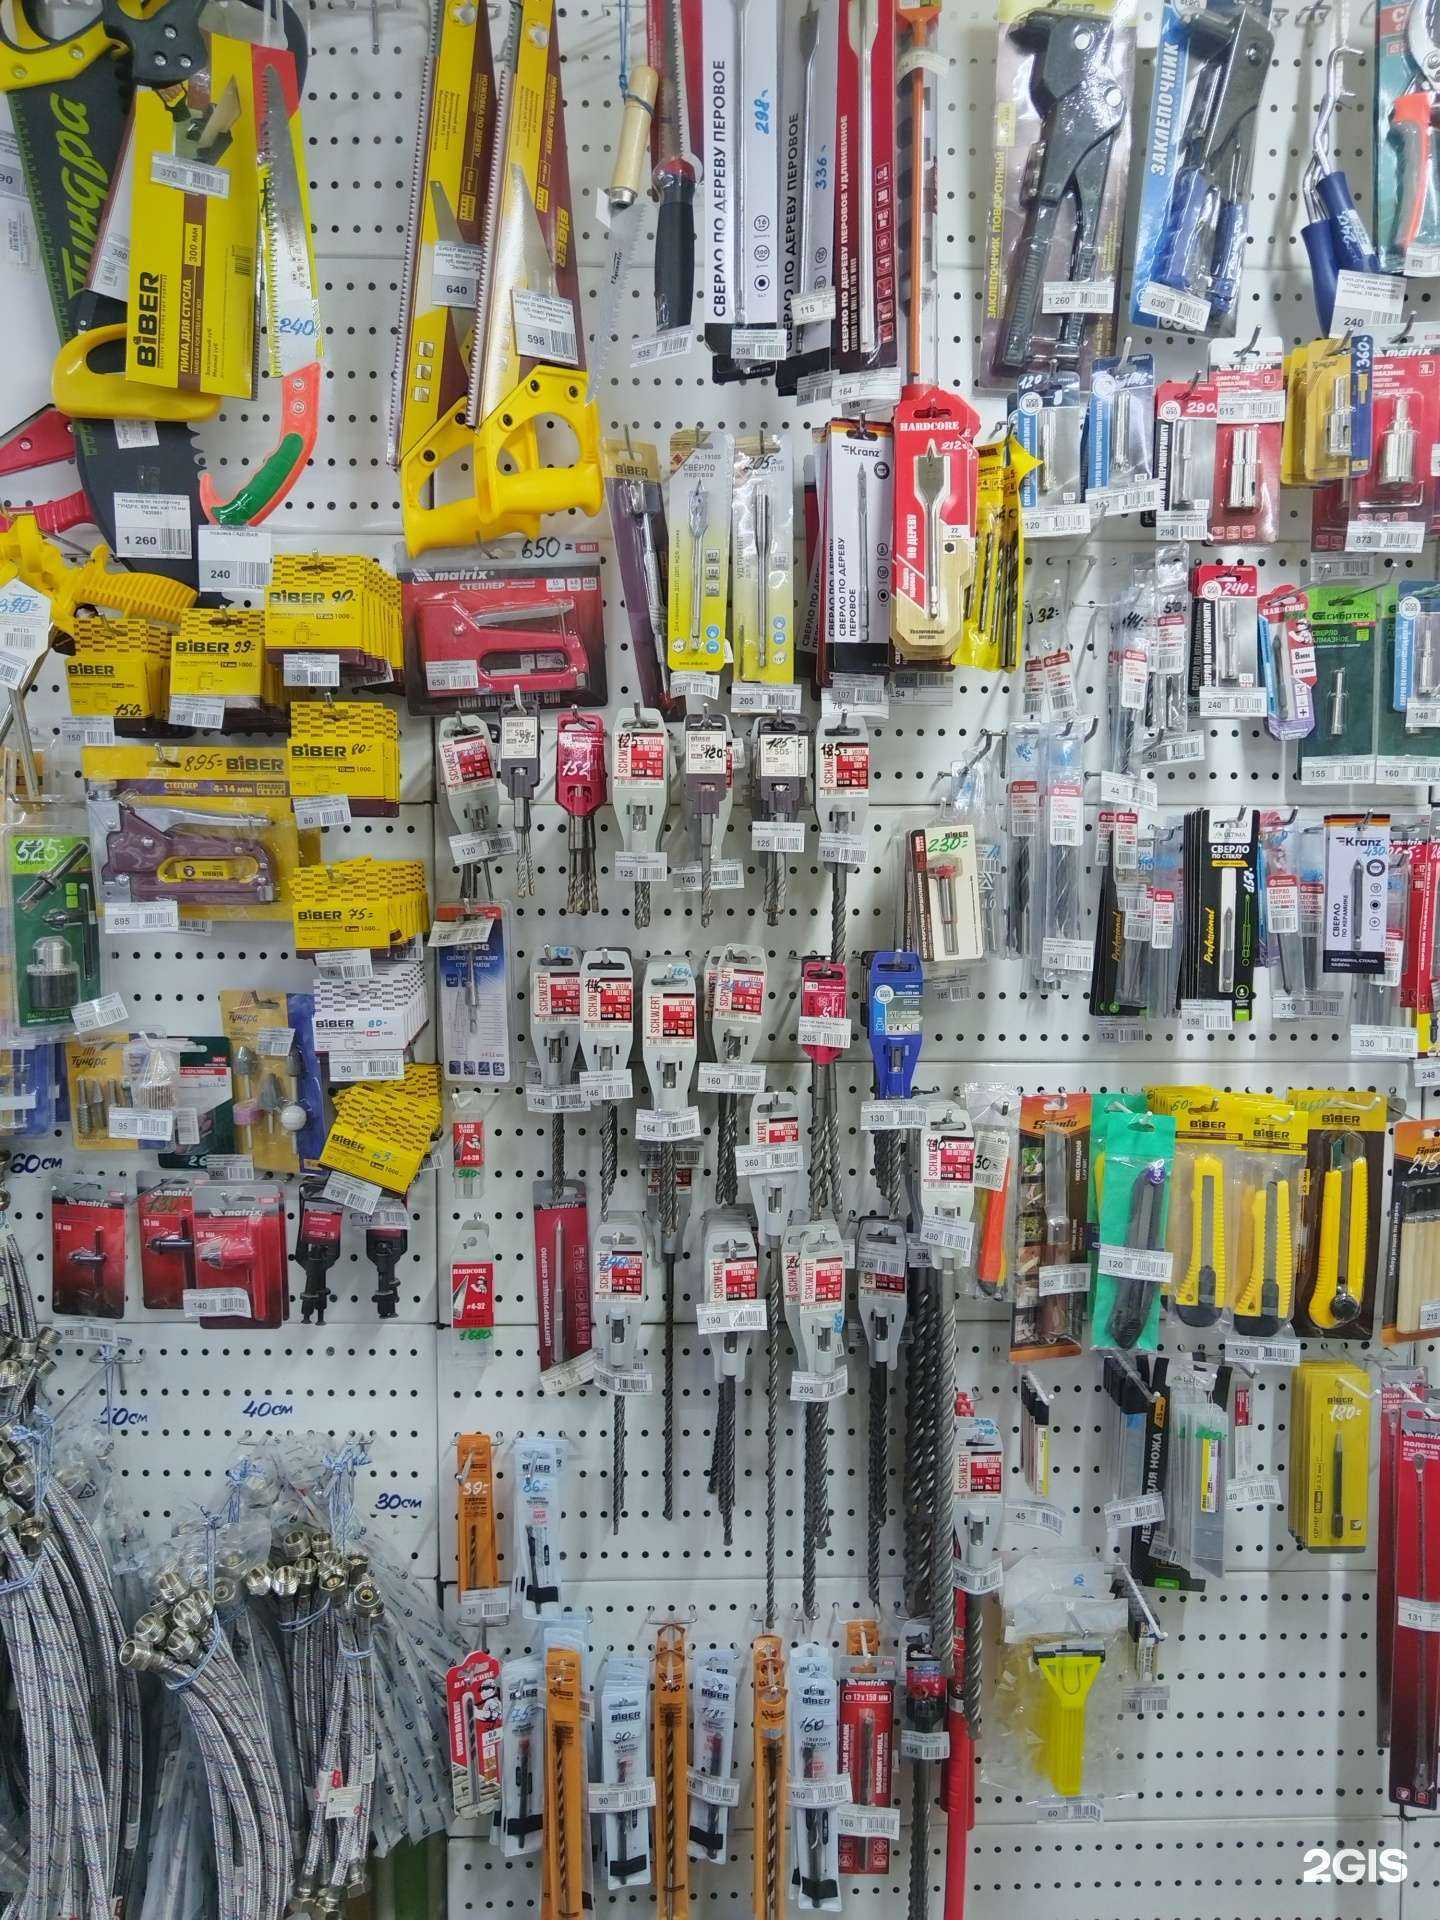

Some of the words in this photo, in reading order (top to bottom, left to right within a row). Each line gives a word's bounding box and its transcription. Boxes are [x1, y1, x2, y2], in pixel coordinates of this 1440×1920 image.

[712, 60, 726, 143] ПЕРОВОЕ
[1151, 41, 1179, 176] ЗАКЛЕПОЧНИК
[787, 113, 799, 190] ПЕРОВОЕ
[840, 115, 849, 190] УДЛИНЕННОЕ
[713, 148, 727, 213] ДЕРЕВУ
[50, 93, 109, 299] Тундра
[991, 152, 1005, 233] ПОВОРОТНЫЙ
[841, 193, 850, 244] ПЕРОВОЕ
[713, 217, 726, 243] ПО
[785, 196, 797, 256] ДЕРЕВУ
[188, 244, 198, 262] 300
[785, 260, 796, 284] ПО
[841, 246, 850, 288] ДЕРЕВУ
[713, 249, 726, 317] СВЕРЛО
[988, 237, 1002, 319] ЗАКЛЕПОЧНИК
[446, 285, 467, 296] 640
[182, 279, 191, 318] СТУСЛА
[841, 292, 849, 306] ПО
[280, 318, 314, 335] 240
[1344, 317, 1364, 328] 240
[181, 319, 192, 340] ДЛЯ
[841, 309, 850, 352] СВЕРЛО
[527, 334, 545, 346] 598
[180, 341, 190, 373] ПИЛА
[1386, 347, 1432, 356] matrix
[900, 421, 960, 432] HARDCORE
[848, 446, 880, 458] Kranz
[683, 463, 716, 472] СВЕРЛО
[1161, 527, 1175, 536] 290
[135, 536, 157, 546] 260
[838, 537, 847, 577] ДЕРЕВУ
[210, 569, 231, 580] 240
[434, 567, 489, 582] matrix
[838, 578, 847, 594] ПО
[838, 596, 847, 637] СВЕРЛО
[848, 589, 857, 637] ПЕРОВОЕ
[1326, 610, 1370, 621] сибртех
[431, 678, 445, 687] 650
[740, 696, 755, 706] 205
[1208, 701, 1222, 709] 240
[562, 761, 590, 777] 152
[1385, 769, 1399, 777] 160
[1345, 837, 1382, 847] Kranz
[1211, 845, 1249, 854] СВЕРЛО
[620, 869, 634, 877] 125
[682, 876, 695, 884] 140
[1332, 903, 1341, 938] СВЕРЛО
[1203, 906, 1216, 964] Professional
[1342, 928, 1348, 938] ПО
[651, 995, 661, 1034] SCHWERT
[802, 1034, 817, 1042] 205
[1360, 1039, 1375, 1048] 330
[340, 1065, 352, 1073] 90
[707, 1077, 721, 1085] 160
[870, 1114, 884, 1122] 130
[744, 1159, 759, 1167] 360
[78, 1198, 110, 1209] matrix
[224, 1207, 262, 1217] matrix
[540, 1247, 548, 1278] СВЕРЛО
[1109, 1260, 1123, 1269] 120
[543, 1279, 551, 1347] ЦЕНТРИРУЮЩЕЕ
[706, 1317, 721, 1325] 190
[1235, 1348, 1250, 1356] 120
[799, 1386, 813, 1394] 205
[1151, 1432, 1162, 1469] НОЖА
[1016, 1512, 1025, 1520] 45
[1408, 1612, 1422, 1622] 131
[857, 1678, 889, 1687] matrix
[598, 1797, 609, 1805] 90
